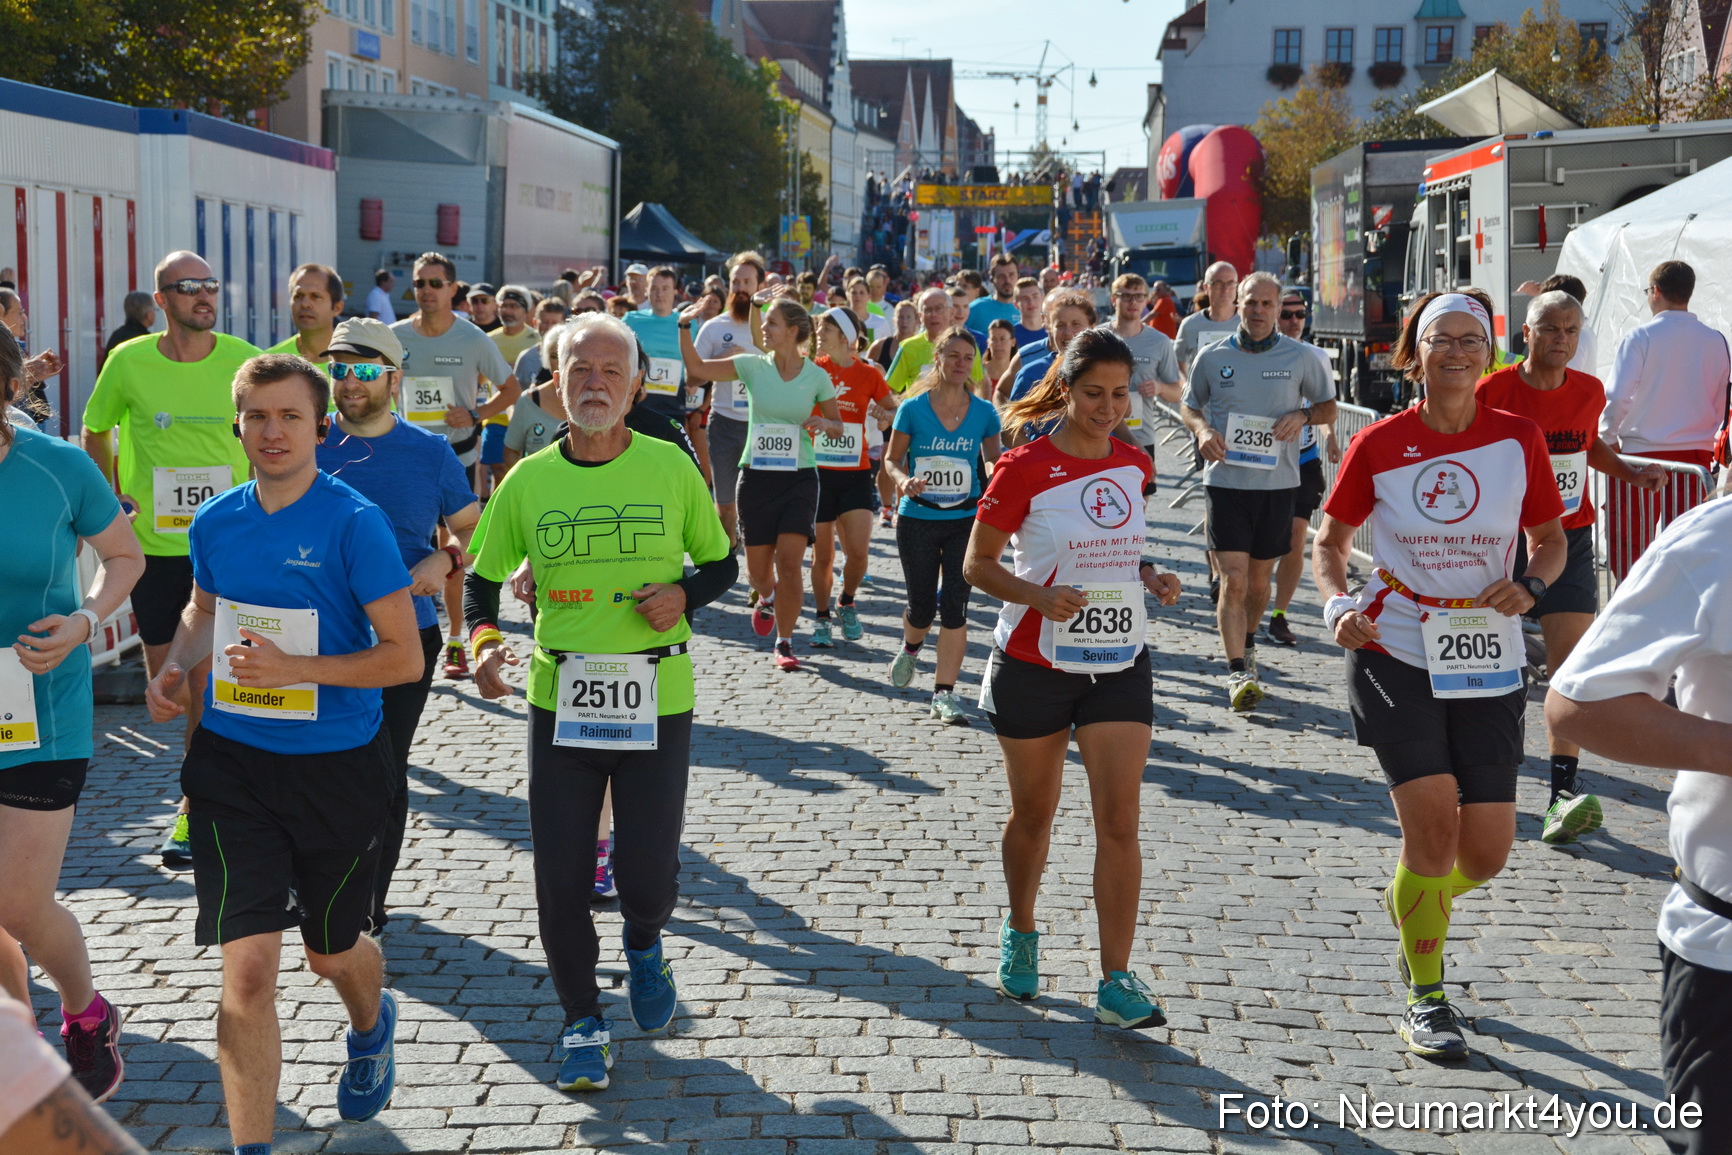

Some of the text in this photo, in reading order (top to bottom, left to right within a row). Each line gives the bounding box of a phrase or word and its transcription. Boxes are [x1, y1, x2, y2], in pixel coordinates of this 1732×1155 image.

[961, 189, 1007, 200] START
[657, 369, 669, 380] 21
[415, 390, 442, 404] 354
[758, 436, 792, 451] 3089
[822, 434, 855, 449] 3090
[919, 436, 974, 451] ...läuft!
[1234, 429, 1273, 447] 2336
[1240, 454, 1261, 462] Martin
[176, 473, 209, 482] BOCK
[923, 471, 963, 486] 2010
[173, 486, 214, 506] 150
[173, 517, 192, 526] Chri
[537, 504, 665, 559] OPF
[1069, 539, 1107, 549] LAUFEN
[1111, 537, 1128, 546] MIT
[1394, 533, 1502, 546] LAUFEN MIT HERZ
[1419, 549, 1440, 558] Heck
[1447, 548, 1459, 556] Dr.
[576, 555, 646, 566] Automatisierungstechnik
[1378, 568, 1406, 593] LEKI
[1451, 599, 1473, 608] LE
[237, 614, 282, 630] BOCK
[1068, 607, 1132, 633] 2638
[1450, 616, 1488, 626] BOCK
[1437, 633, 1501, 661] 2605
[1082, 650, 1118, 661] Sevinc
[584, 662, 628, 672] BOCK
[1364, 667, 1396, 708] SALOMON
[1467, 676, 1483, 687] Ina
[233, 687, 286, 706] Leander
[572, 680, 641, 709] 2510
[580, 725, 632, 739] Raimund
